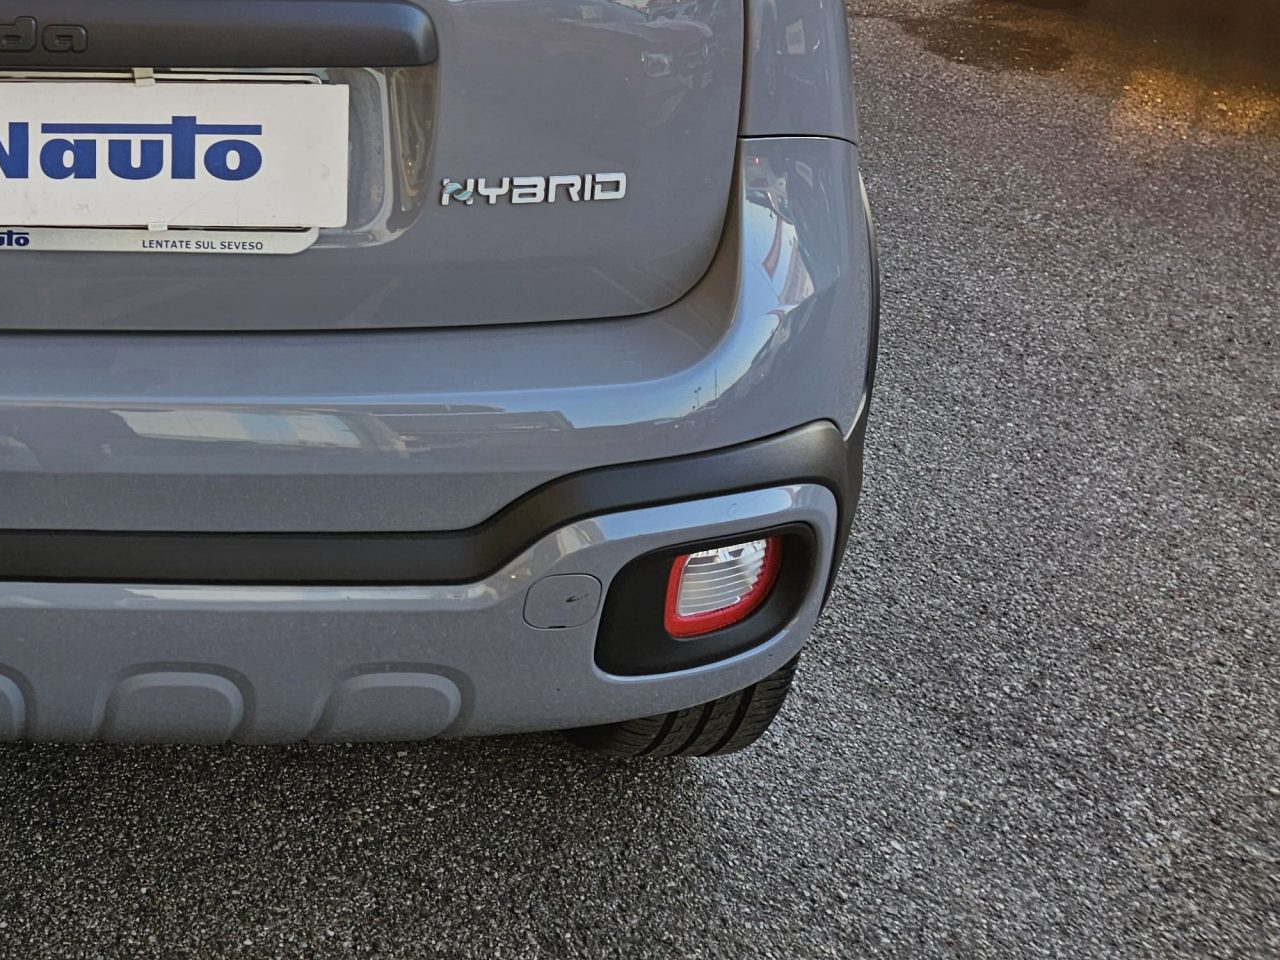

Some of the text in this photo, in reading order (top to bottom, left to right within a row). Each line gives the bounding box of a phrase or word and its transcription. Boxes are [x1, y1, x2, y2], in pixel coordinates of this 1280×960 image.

[441, 172, 627, 206] HYBRID
[142, 239, 263, 250] LENTATE SUL SEVESO
